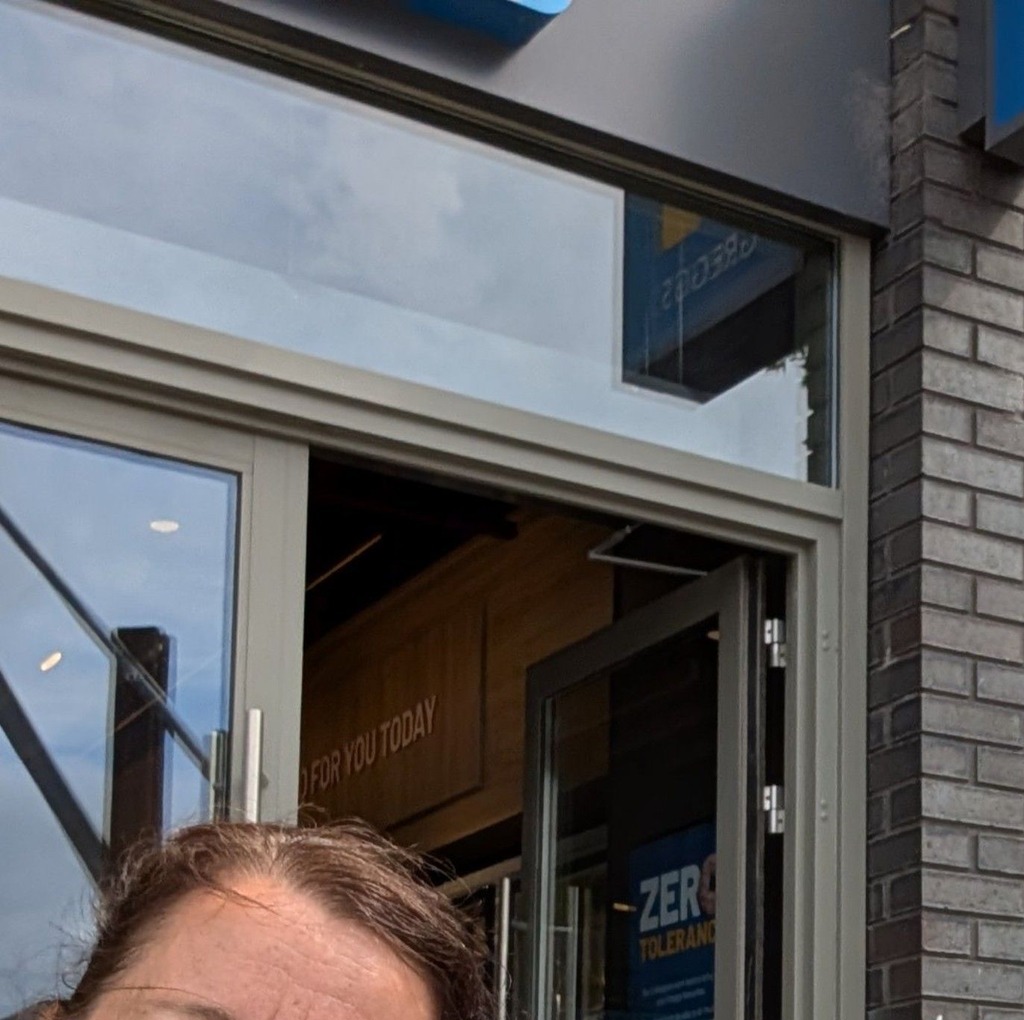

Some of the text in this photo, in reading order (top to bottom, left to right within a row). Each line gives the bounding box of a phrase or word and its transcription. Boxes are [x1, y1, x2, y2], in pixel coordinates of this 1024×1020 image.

[310, 749, 341, 794] FOR
[343, 729, 376, 774] YOU
[380, 695, 437, 757] TODAY
